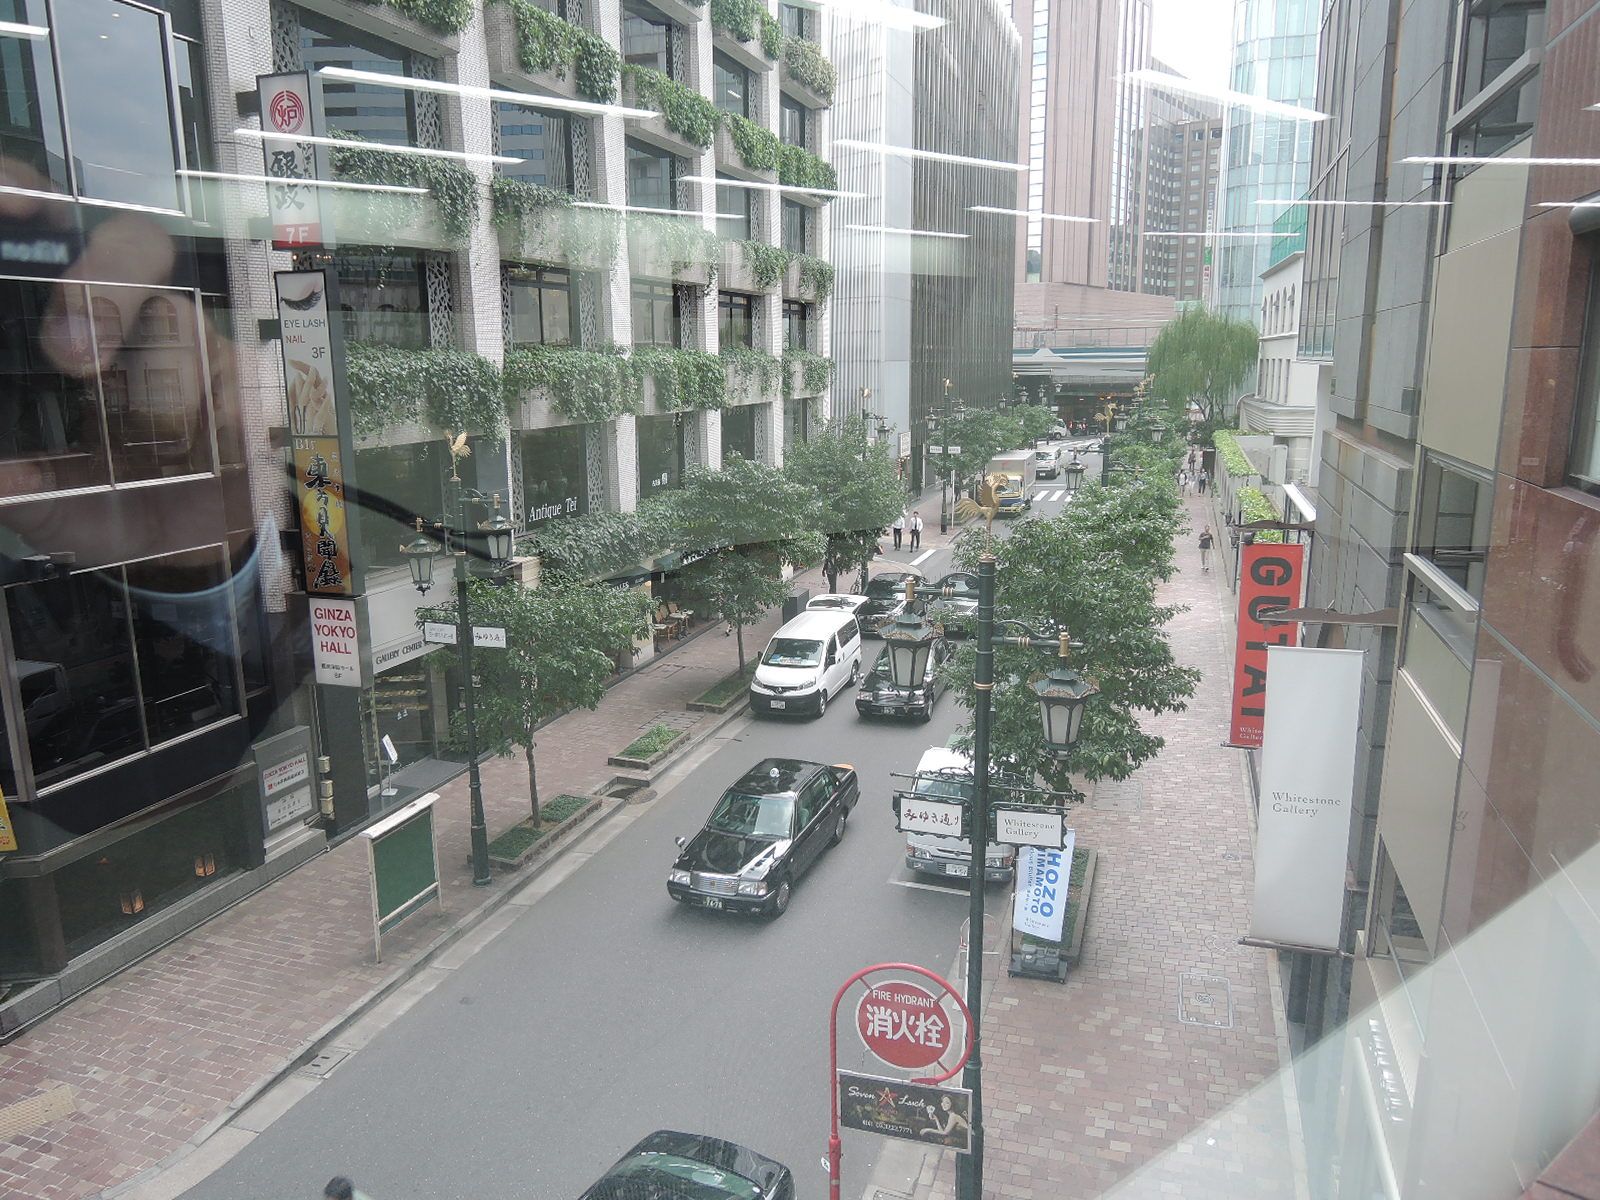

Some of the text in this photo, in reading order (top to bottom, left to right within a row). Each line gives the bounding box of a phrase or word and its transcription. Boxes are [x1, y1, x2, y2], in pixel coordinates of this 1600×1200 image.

[286, 226, 309, 244] 7F
[284, 319, 326, 329] EYE LASH
[285, 335, 306, 344] NAIL
[311, 346, 326, 359] 3F
[529, 502, 562, 522] Antique
[314, 607, 353, 622] GINZA
[314, 623, 356, 639] YOKYO
[320, 641, 352, 655] HALL
[375, 649, 400, 665] GALLERY
[1272, 791, 1342, 806] Whitestone
[903, 808, 959, 826] みゆき通り
[1272, 802, 1319, 818] Gallery
[1004, 818, 1055, 830] Whitestone
[1005, 827, 1040, 840] Gallery
[872, 989, 936, 1008] FIRE HYDRANT
[866, 1004, 945, 1048] 消火栓
[847, 1086, 876, 1100] Seven
